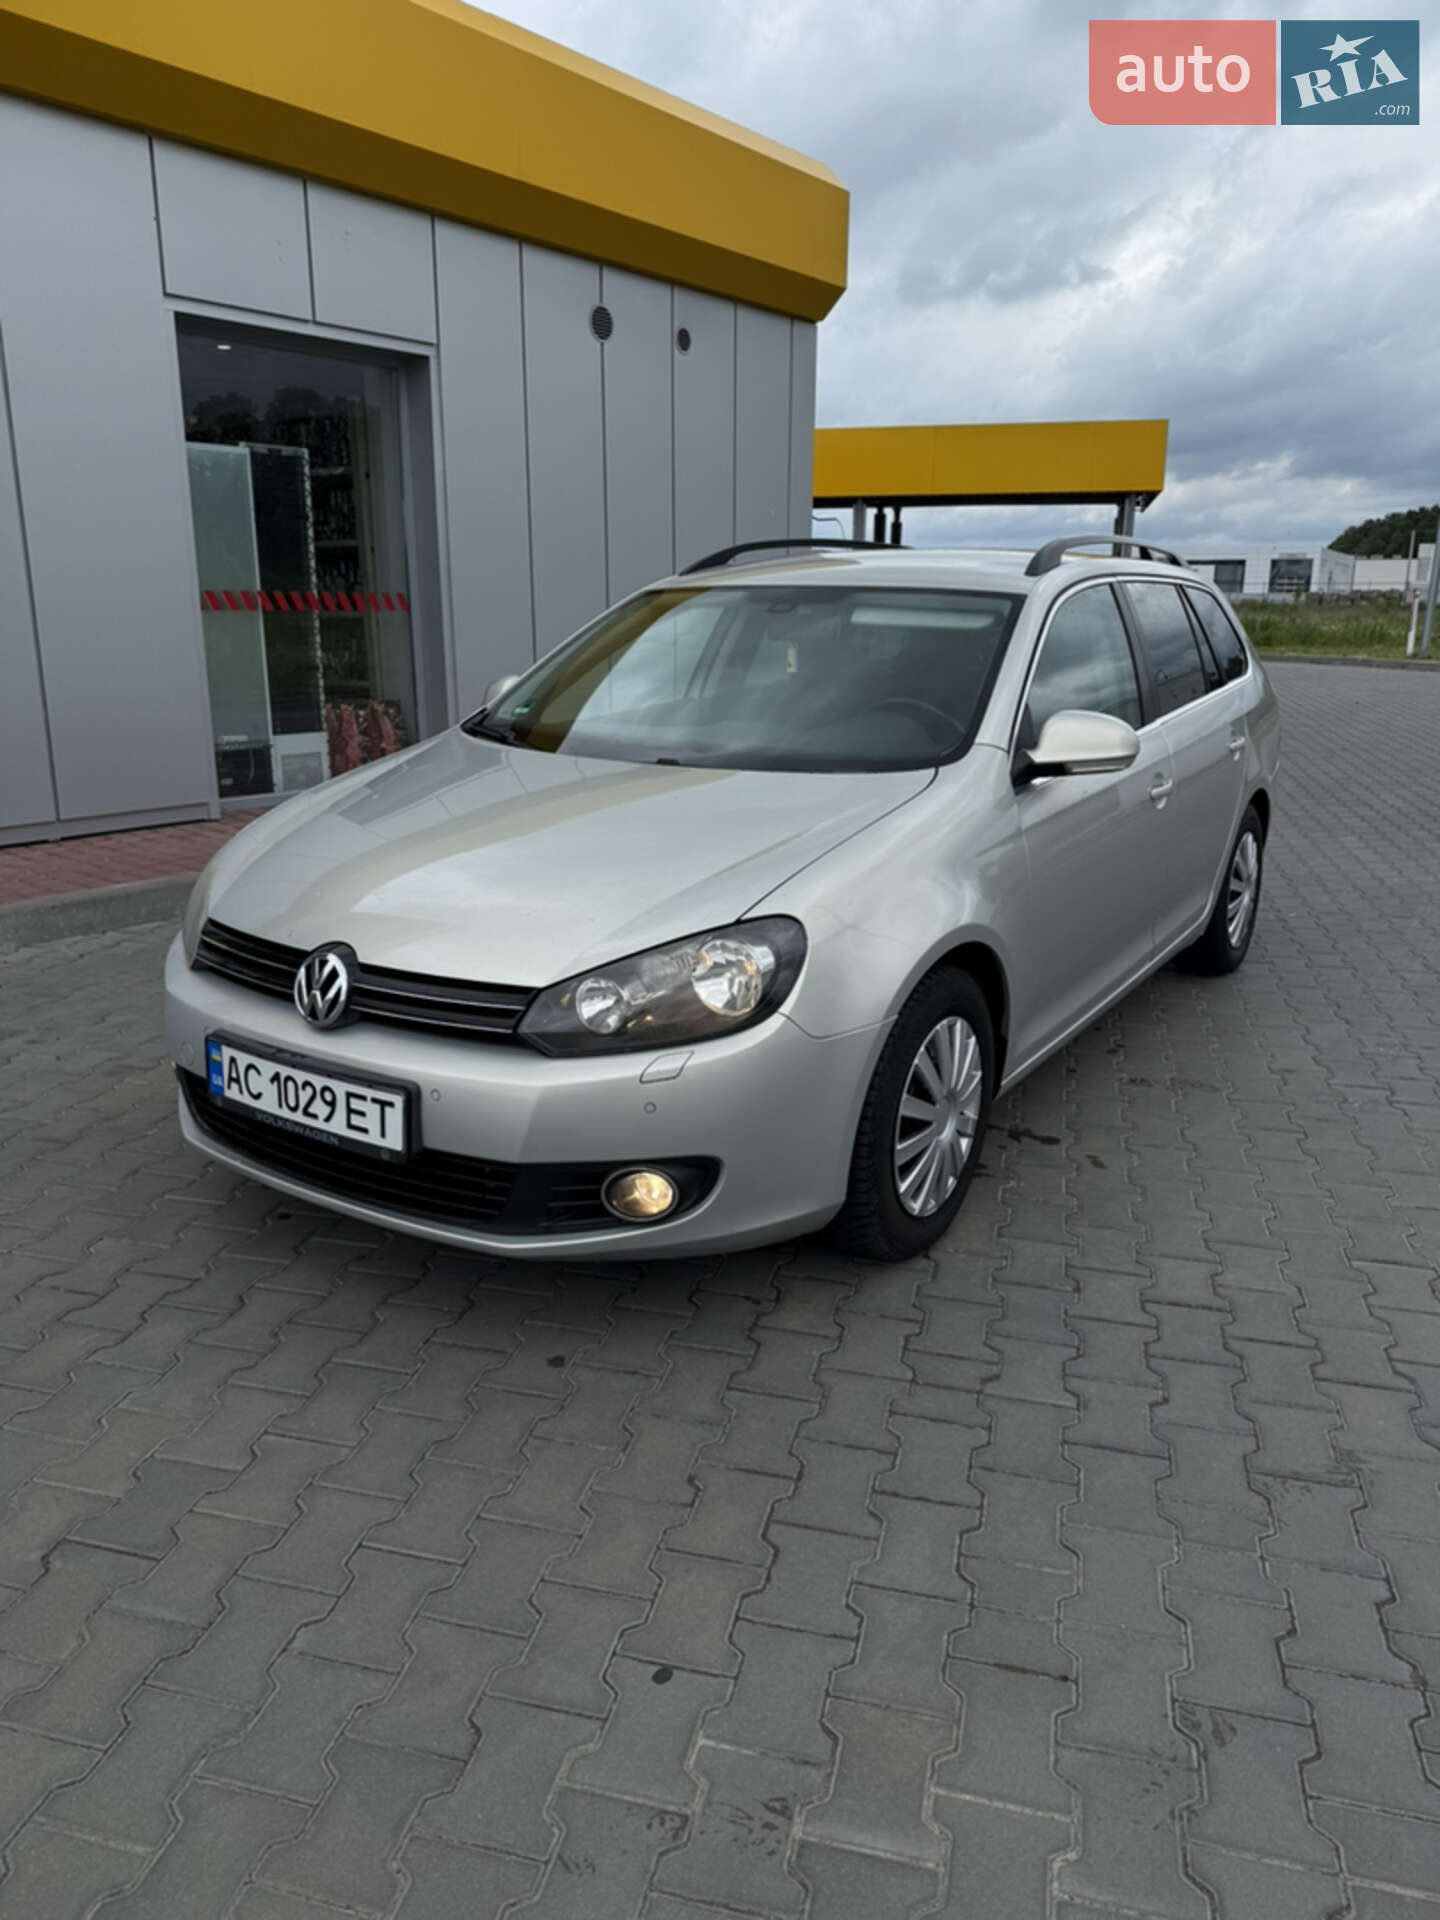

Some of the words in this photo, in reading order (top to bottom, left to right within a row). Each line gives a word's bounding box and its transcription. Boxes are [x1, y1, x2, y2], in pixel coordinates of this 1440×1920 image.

[226, 1055, 263, 1101] AC
[270, 1071, 337, 1124] 1029
[345, 1091, 396, 1140] ET
